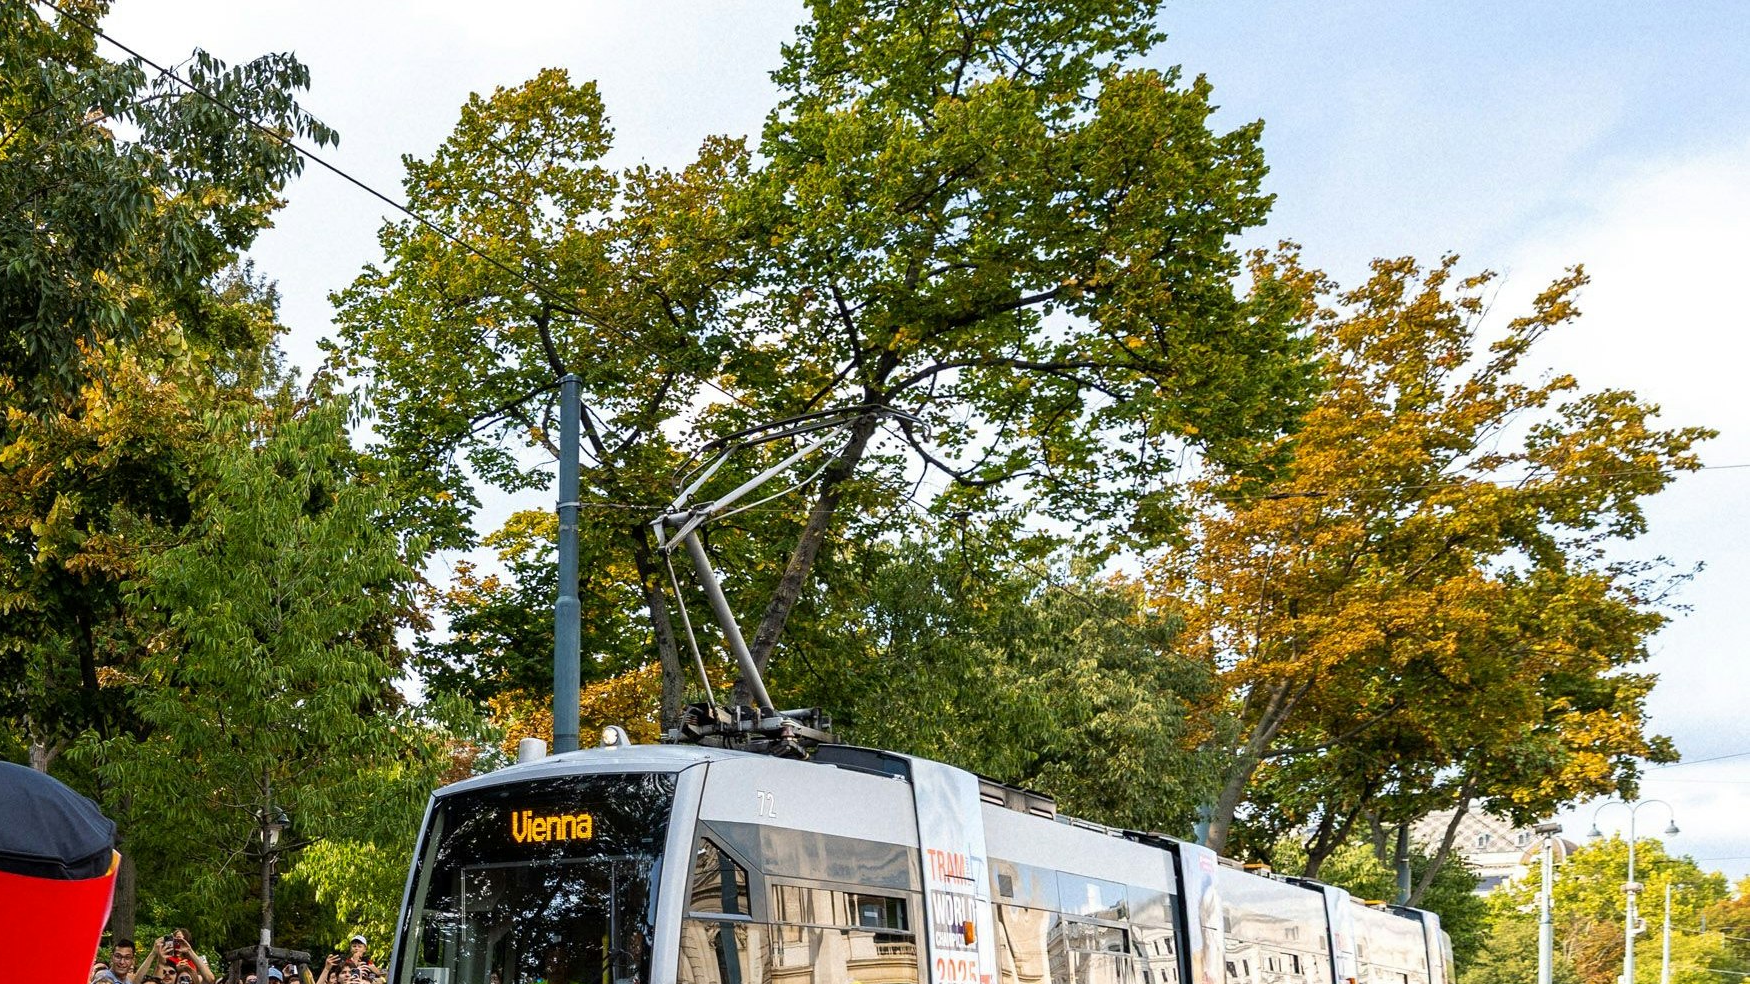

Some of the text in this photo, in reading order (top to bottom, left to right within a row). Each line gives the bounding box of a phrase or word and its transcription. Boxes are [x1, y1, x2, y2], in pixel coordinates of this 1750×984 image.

[756, 789, 777, 818] 72
[511, 810, 593, 843] Vienna
[926, 848, 965, 887] TRAM
